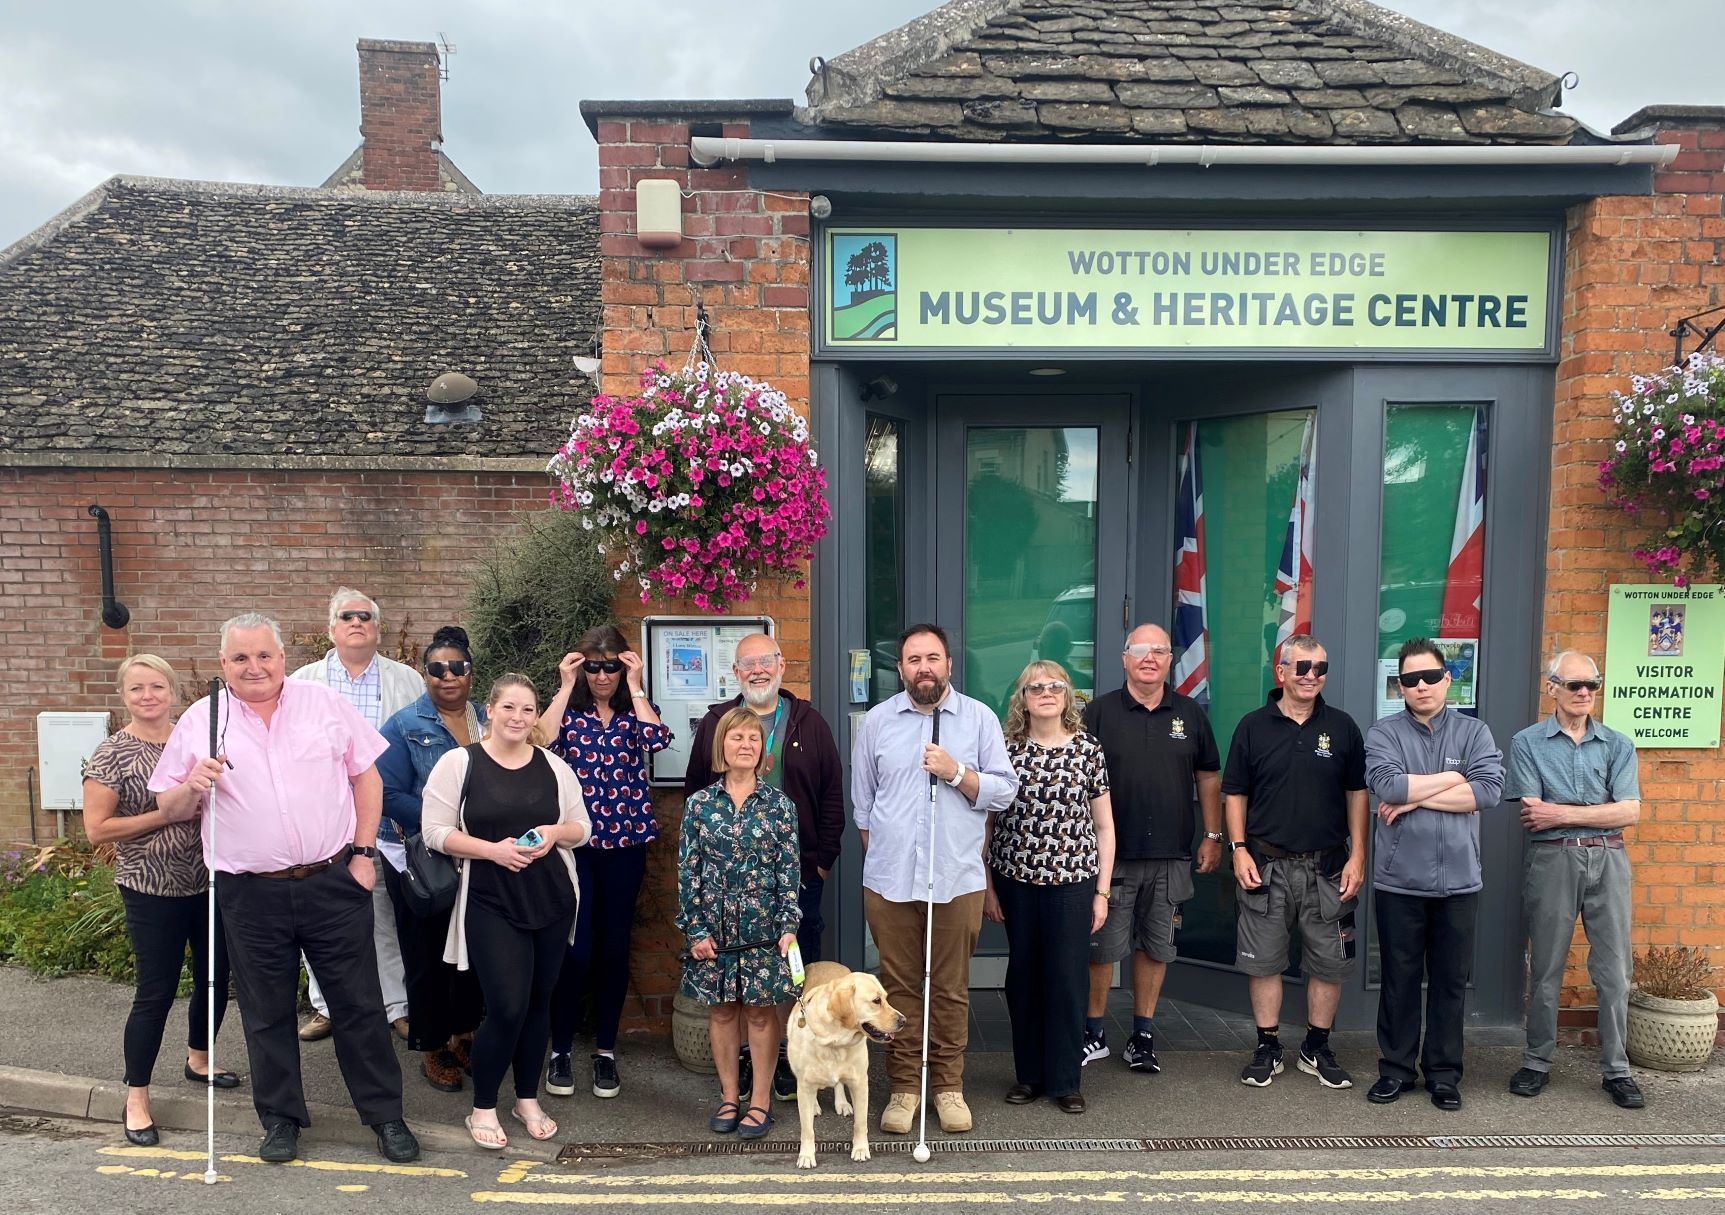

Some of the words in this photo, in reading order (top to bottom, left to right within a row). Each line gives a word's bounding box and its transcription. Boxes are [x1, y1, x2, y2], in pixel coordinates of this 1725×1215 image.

[1068, 250, 1191, 275] WOTTON
[1201, 250, 1301, 276] UNDER
[1310, 251, 1386, 277] EDGE
[920, 291, 1097, 325] MUSEUM
[1112, 292, 1140, 325] &
[1154, 292, 1354, 326] HERITAGE
[1368, 294, 1528, 328] CENTRE
[1625, 591, 1659, 599] WOTTON
[1661, 591, 1690, 599] UNDER
[1692, 591, 1714, 599] EDGE
[1636, 665, 1694, 678] VISITOR
[1613, 686, 1714, 699] INFORMATION
[1633, 707, 1692, 719] CENTRE
[1634, 728, 1689, 738] WELCOME
